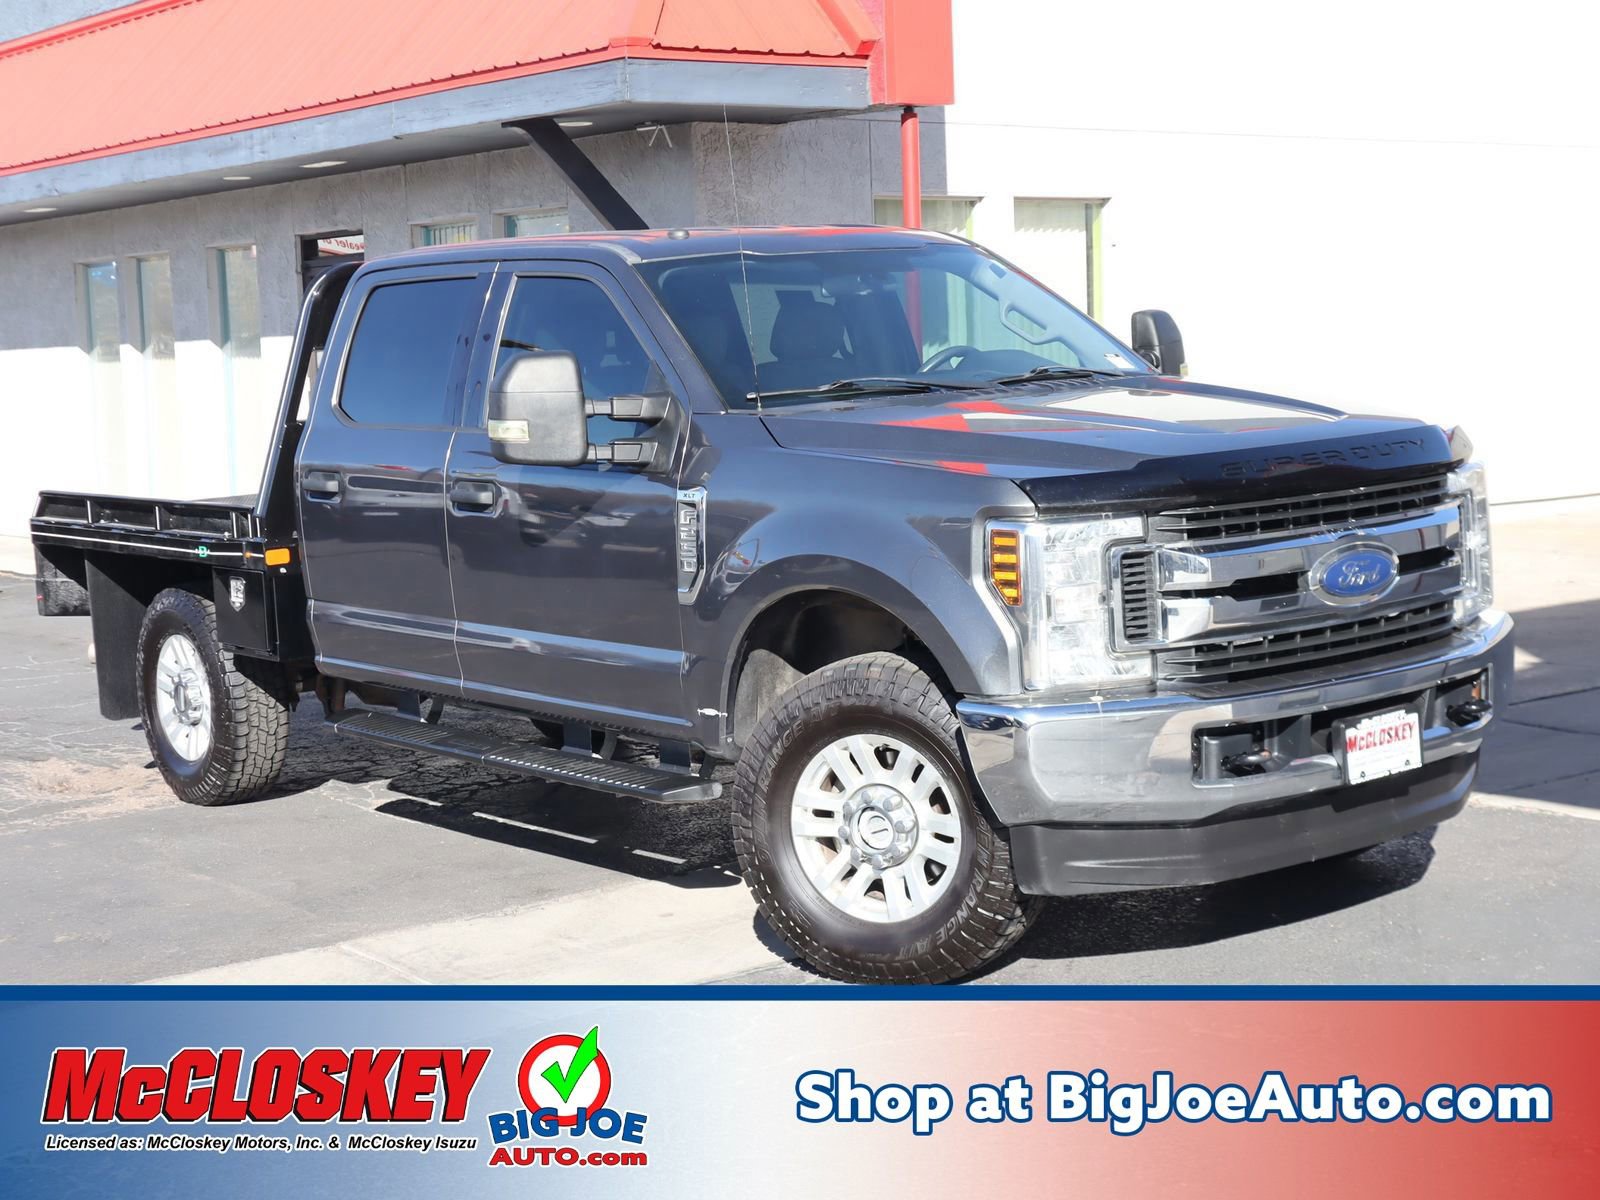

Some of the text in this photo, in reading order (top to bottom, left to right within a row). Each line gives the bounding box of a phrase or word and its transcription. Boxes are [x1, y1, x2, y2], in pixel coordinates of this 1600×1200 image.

[1220, 438, 1424, 479] SUPER DUTY
[1338, 559, 1380, 588] Ford
[935, 867, 987, 946] RANGE
